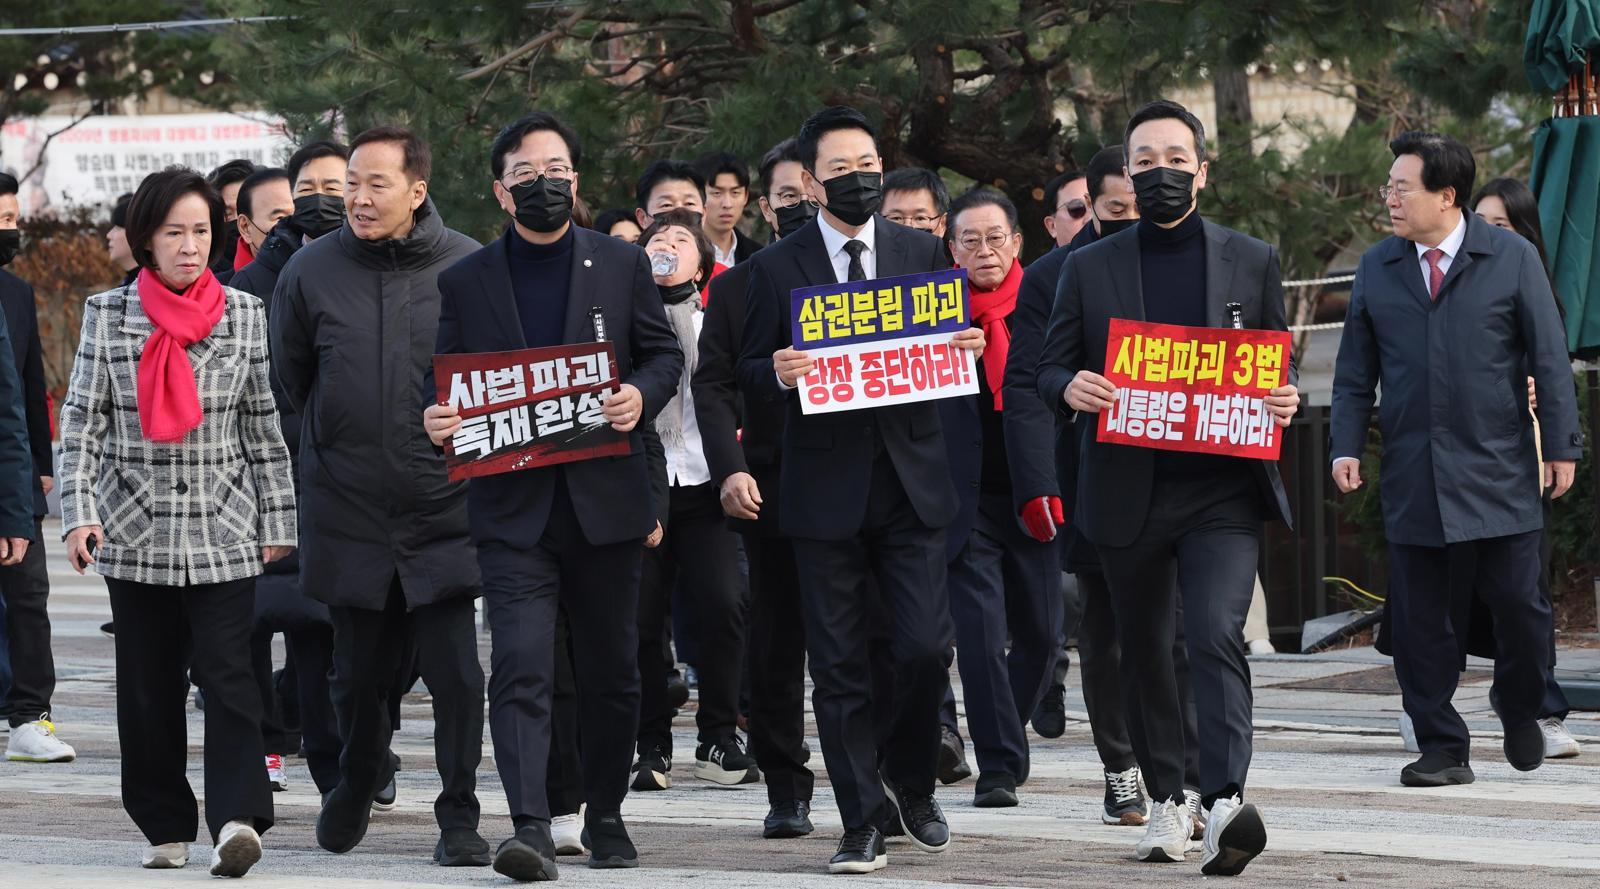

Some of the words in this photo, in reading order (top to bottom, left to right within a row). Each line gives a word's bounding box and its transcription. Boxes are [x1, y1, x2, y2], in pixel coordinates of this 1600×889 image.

[798, 285, 904, 342] 삼권분립
[911, 278, 964, 327] 파괴
[447, 364, 527, 410] 사법
[529, 351, 615, 394] 파괴
[804, 354, 855, 405] 당장
[859, 341, 971, 399] 중단하라!
[1112, 334, 1227, 386] 사법파괴
[1232, 343, 1283, 390] 3법
[452, 405, 533, 459] 독재
[535, 388, 613, 438] 완성
[1106, 387, 1188, 441] 대통령은
[1193, 393, 1275, 447] 거부하라!
